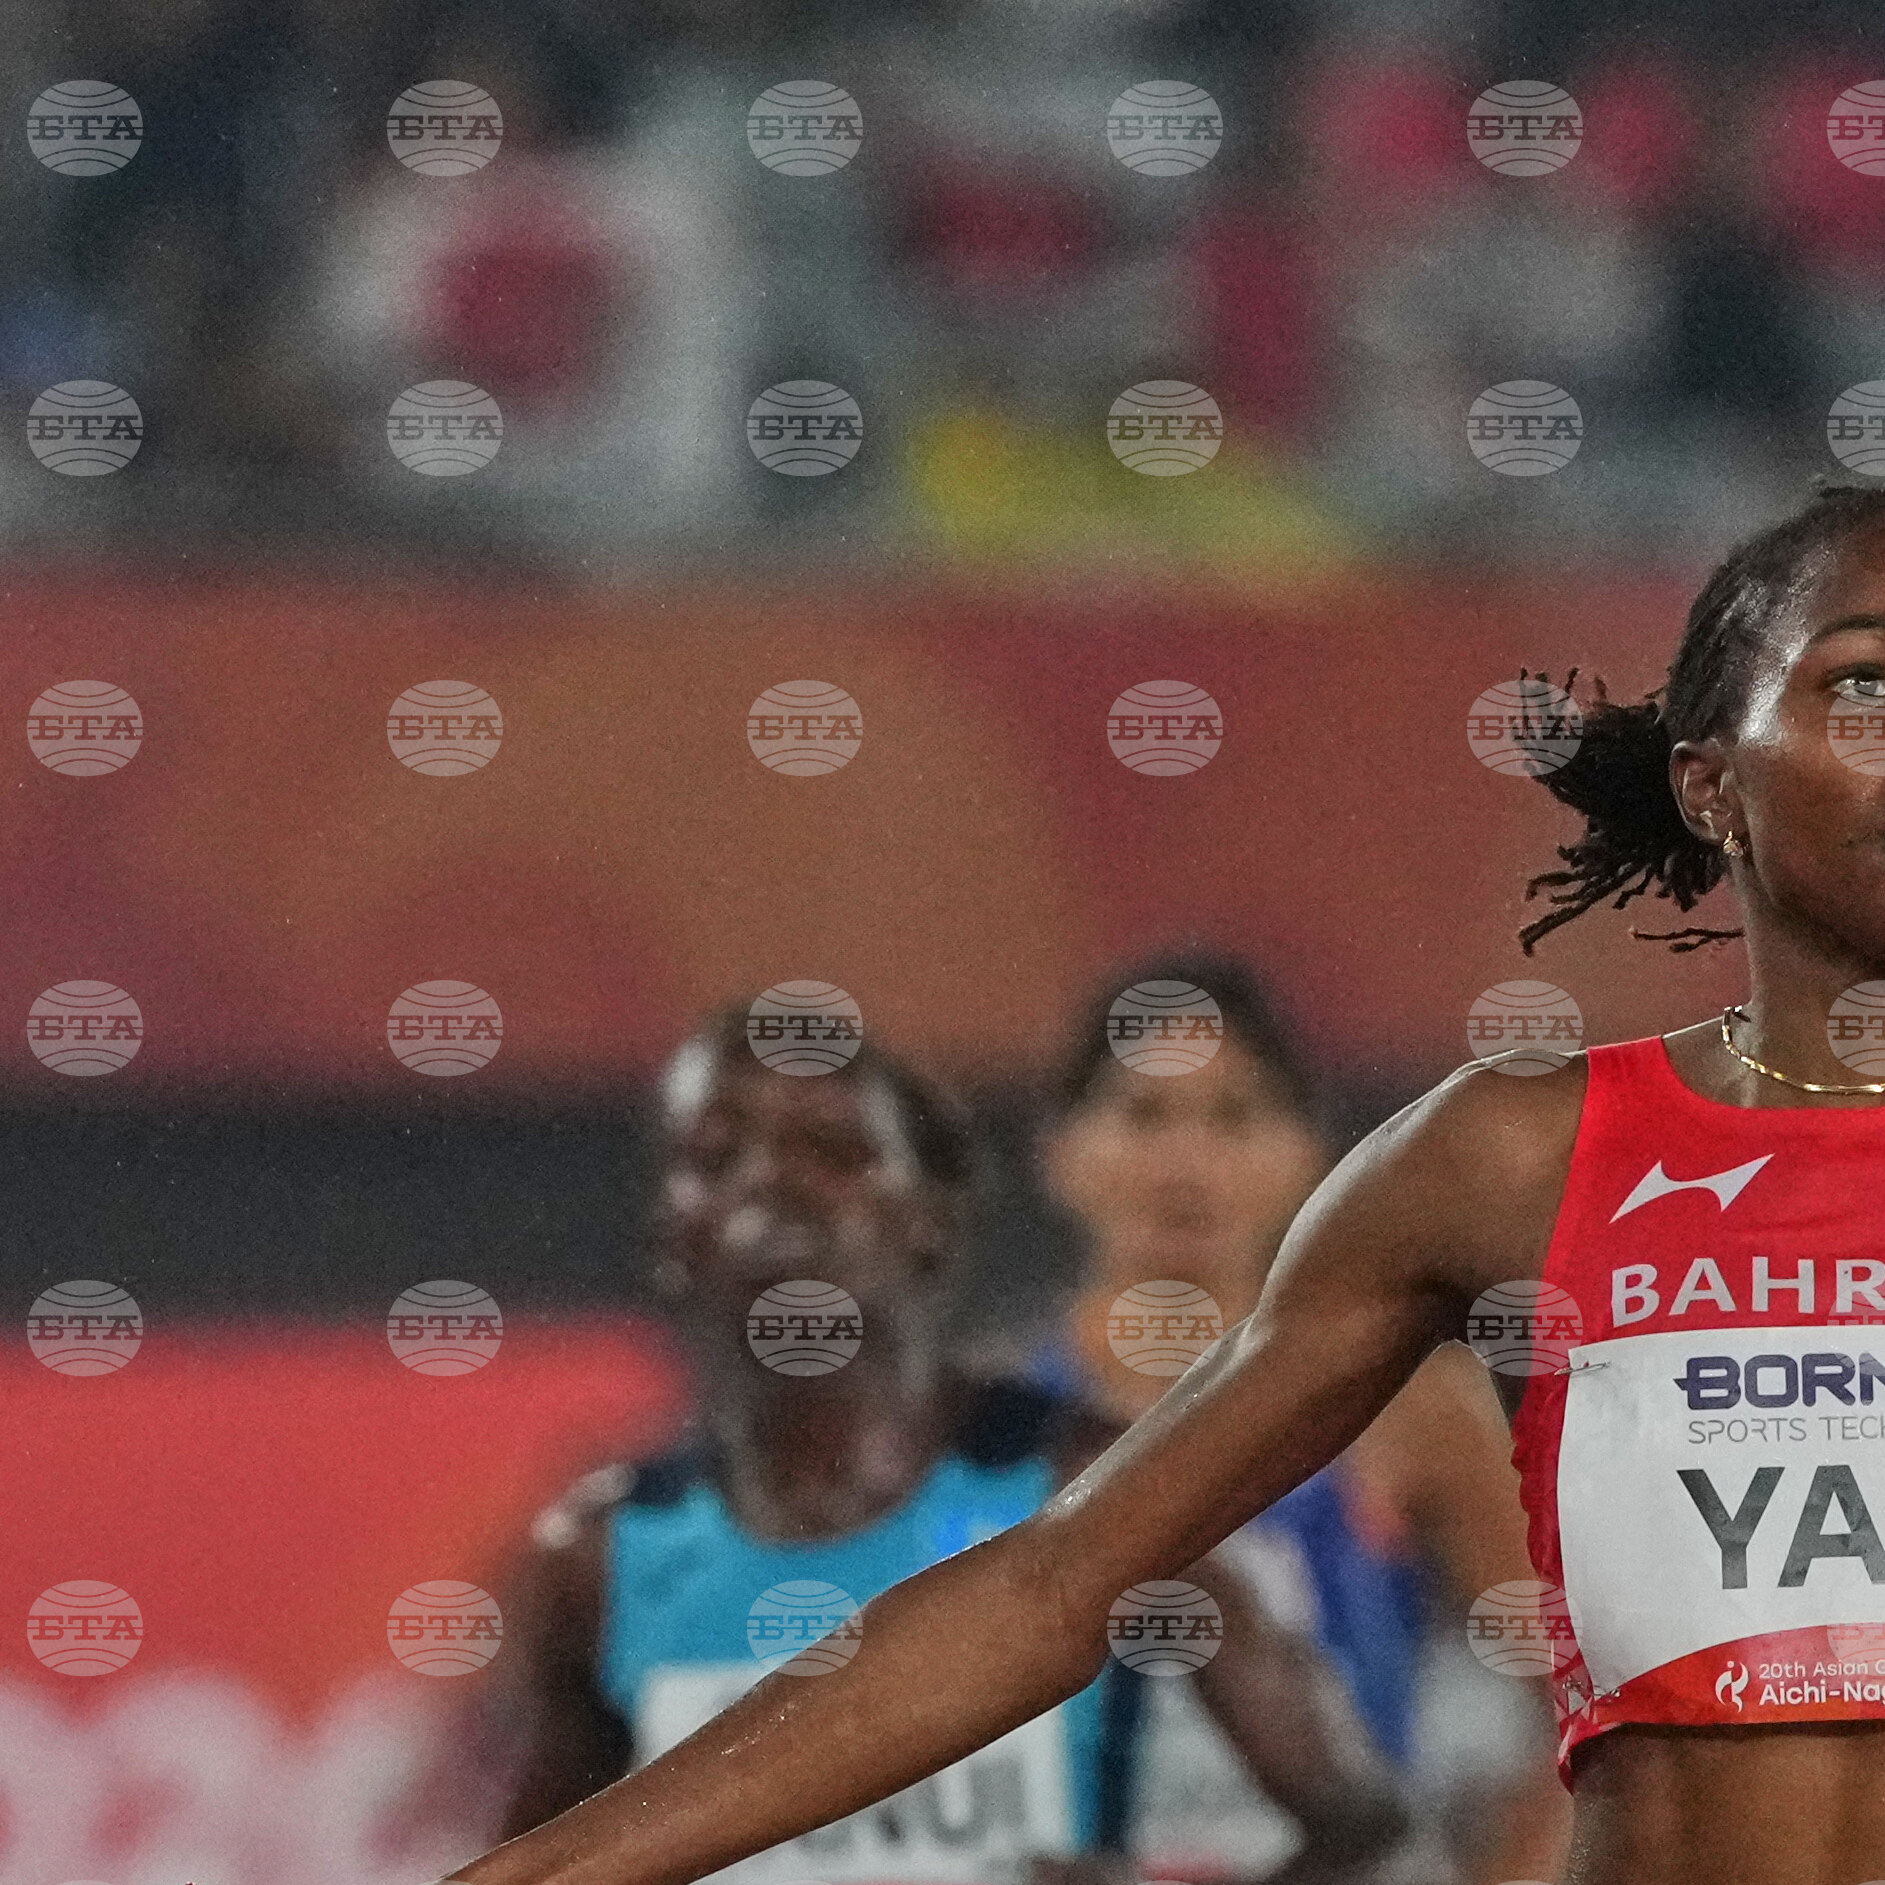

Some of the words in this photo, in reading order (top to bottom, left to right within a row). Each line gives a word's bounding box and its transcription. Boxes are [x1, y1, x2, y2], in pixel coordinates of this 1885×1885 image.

[1688, 1418, 1808, 1444] SPORTS
[1758, 1661, 1806, 1680] 20th
[1813, 1659, 1869, 1678] Asian
